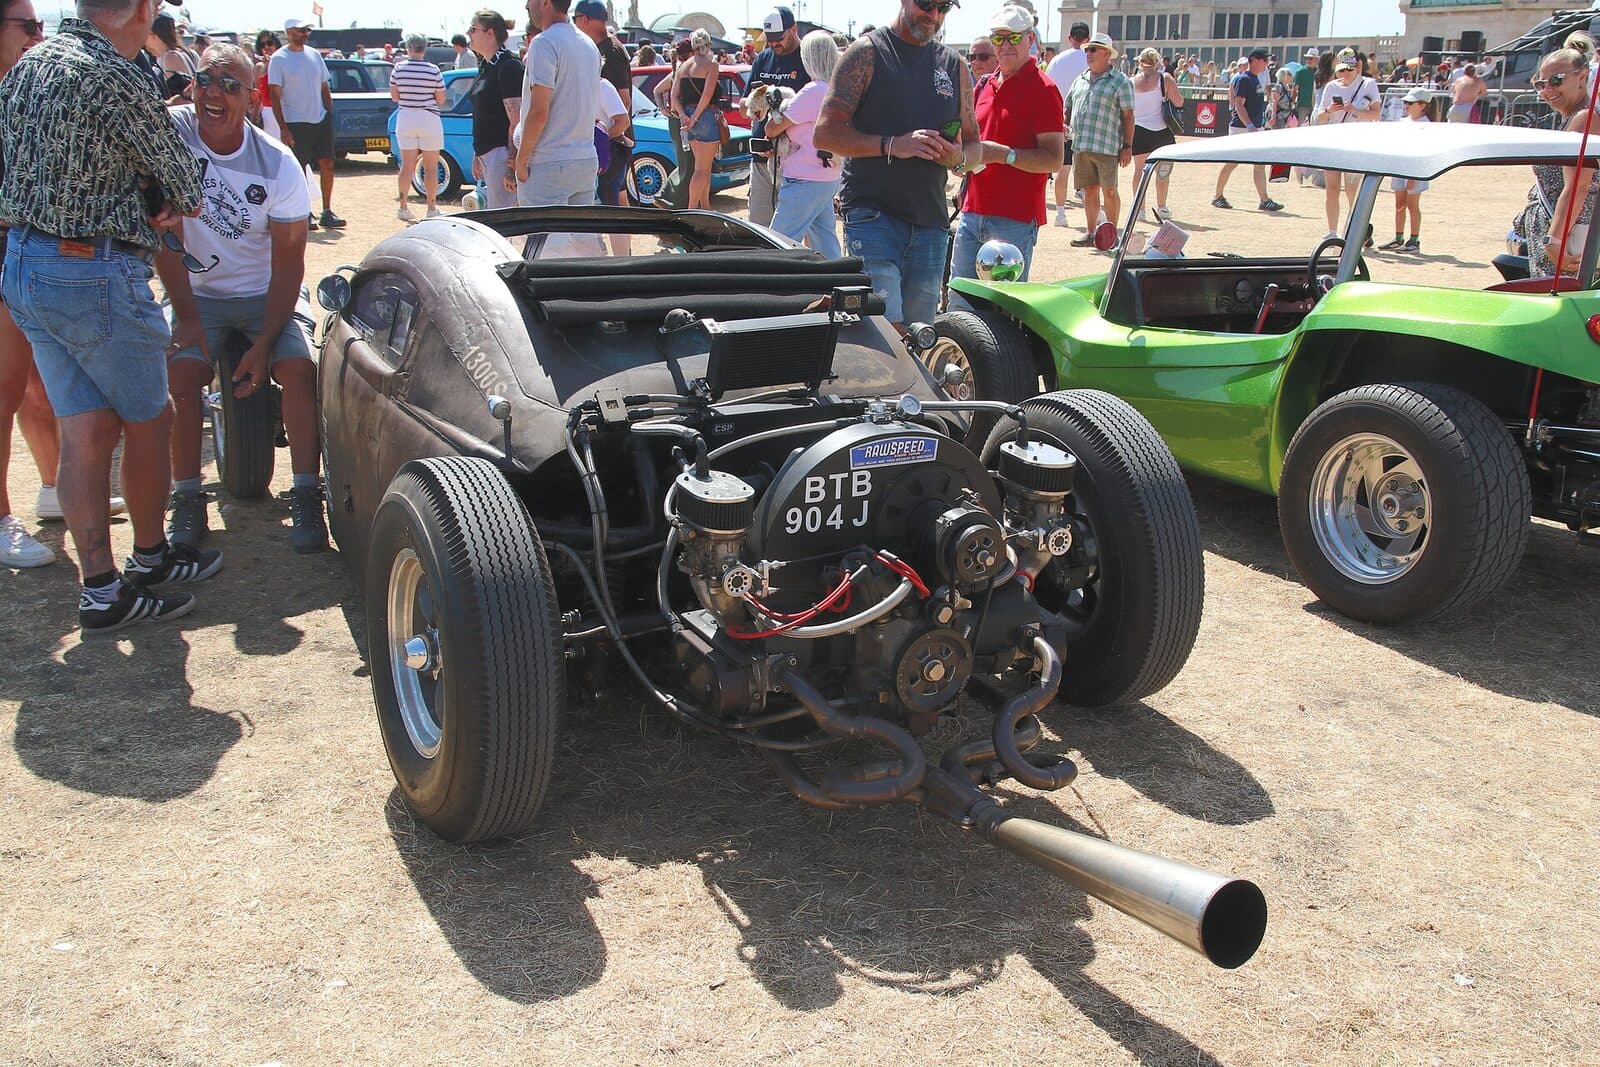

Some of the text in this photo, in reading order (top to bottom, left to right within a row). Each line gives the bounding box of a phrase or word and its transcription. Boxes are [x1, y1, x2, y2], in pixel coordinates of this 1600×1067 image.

[714, 424, 733, 433] CSP
[864, 440, 925, 459] RAWSPEED
[804, 470, 872, 504] BTB
[785, 500, 869, 534] 904 J
